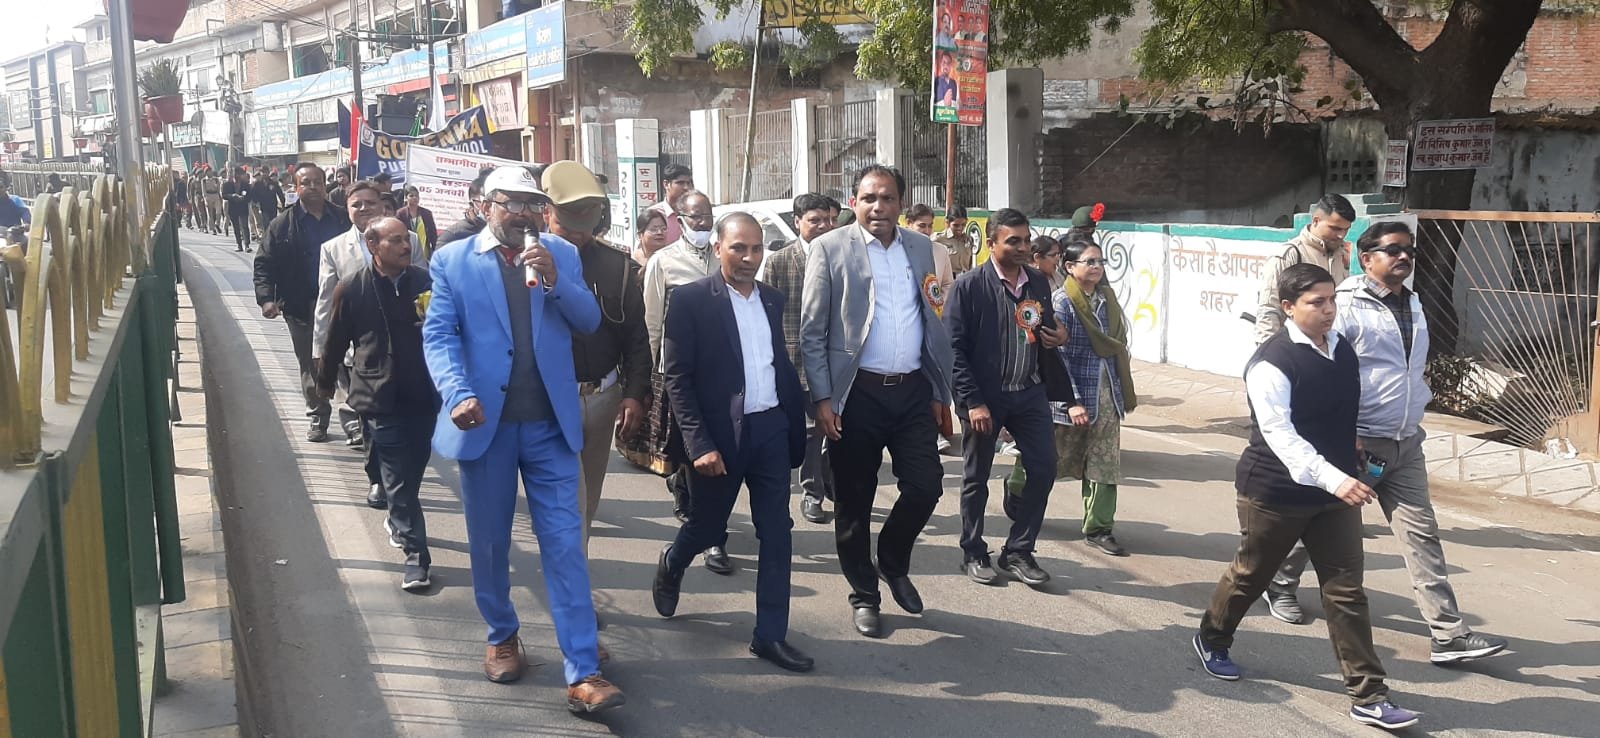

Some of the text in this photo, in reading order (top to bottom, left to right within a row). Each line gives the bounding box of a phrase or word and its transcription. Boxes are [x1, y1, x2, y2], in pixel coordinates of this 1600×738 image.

[1452, 139, 1471, 151] कुमार
[1450, 153, 1470, 165] कुमार
[435, 187, 465, 197] जनवरी
[1170, 238, 1205, 273] कैसा
[1206, 239, 1219, 276] है
[1200, 290, 1238, 313] शहर
